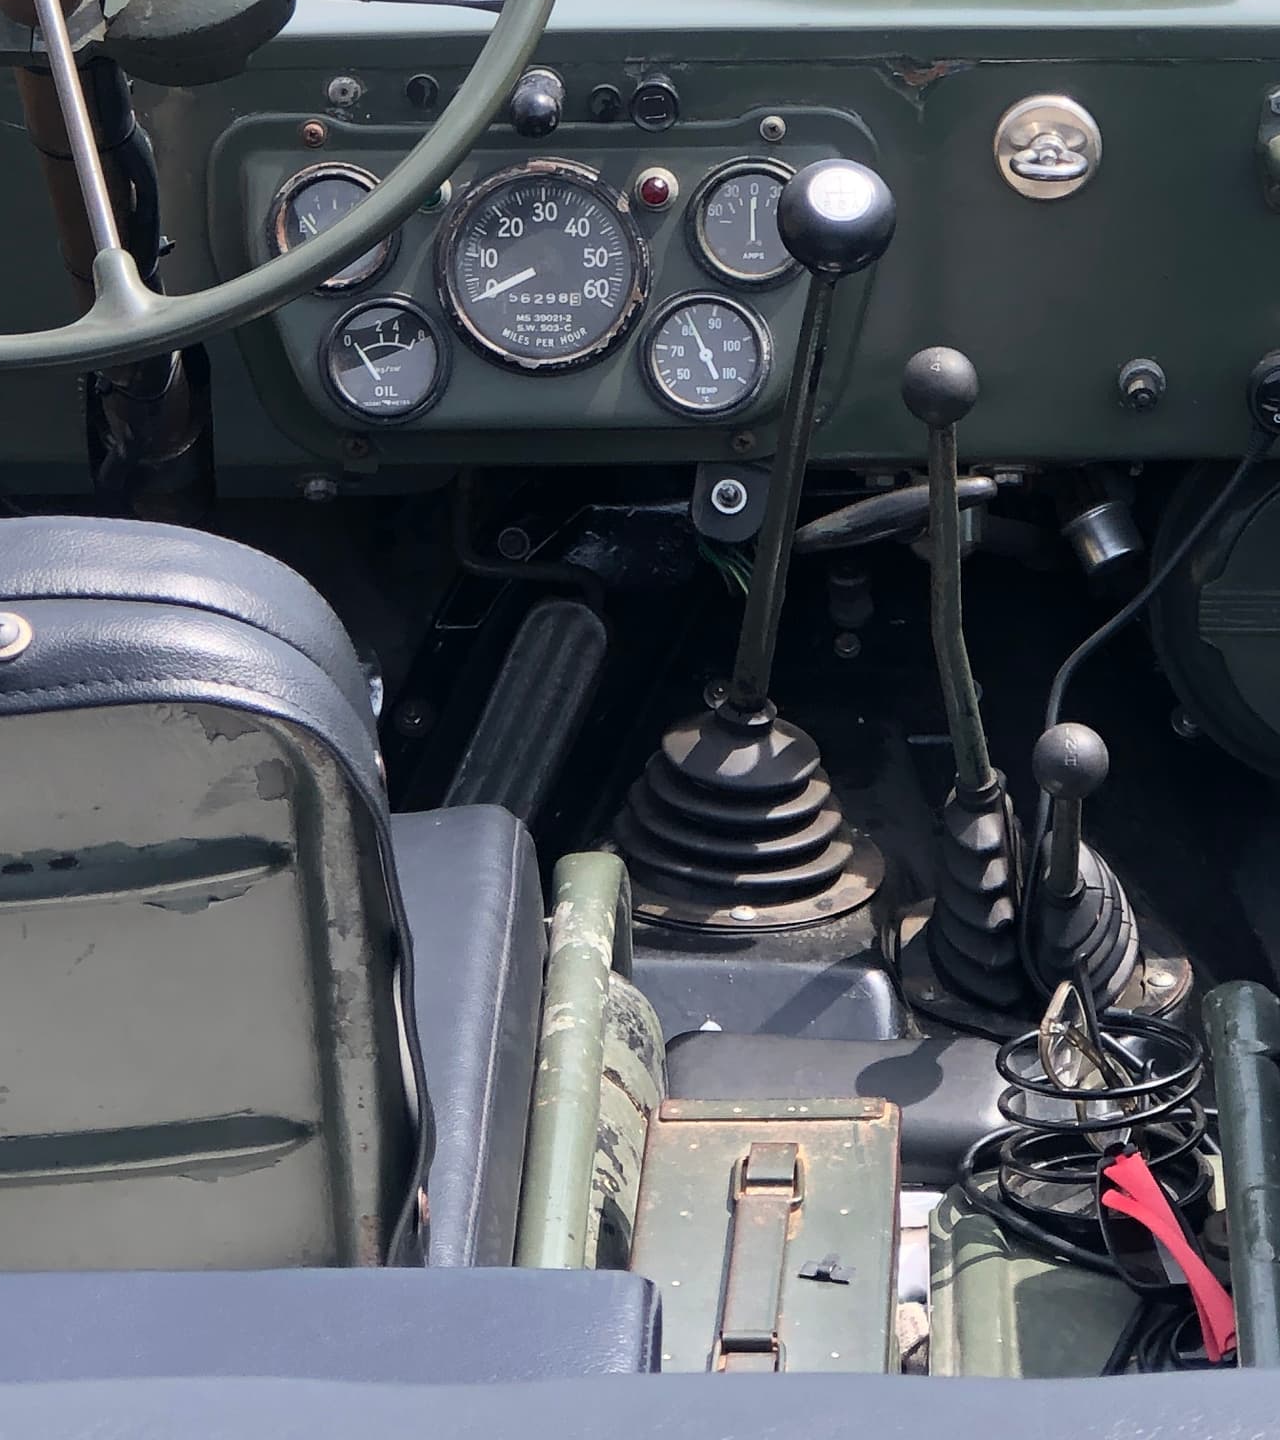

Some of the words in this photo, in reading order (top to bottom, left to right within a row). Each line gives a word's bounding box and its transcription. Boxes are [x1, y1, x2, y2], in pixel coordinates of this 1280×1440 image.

[751, 183, 758, 195] 0
[532, 202, 557, 222] 30
[498, 218, 523, 237] 20
[565, 218, 589, 237] 40
[481, 249, 497, 268] 10
[584, 249, 608, 268] 50
[584, 280, 609, 299] 60
[376, 320, 382, 331] 2
[393, 320, 399, 331] 4
[708, 319, 721, 329] 90
[344, 335, 351, 346] 0
[502, 328, 529, 345] MILES
[536, 338, 554, 347] PER
[560, 329, 587, 344] HOUR
[671, 346, 684, 357] 70
[723, 341, 740, 351] 100
[677, 368, 690, 379] 50
[723, 368, 736, 379] 110
[375, 386, 398, 396] OIL
